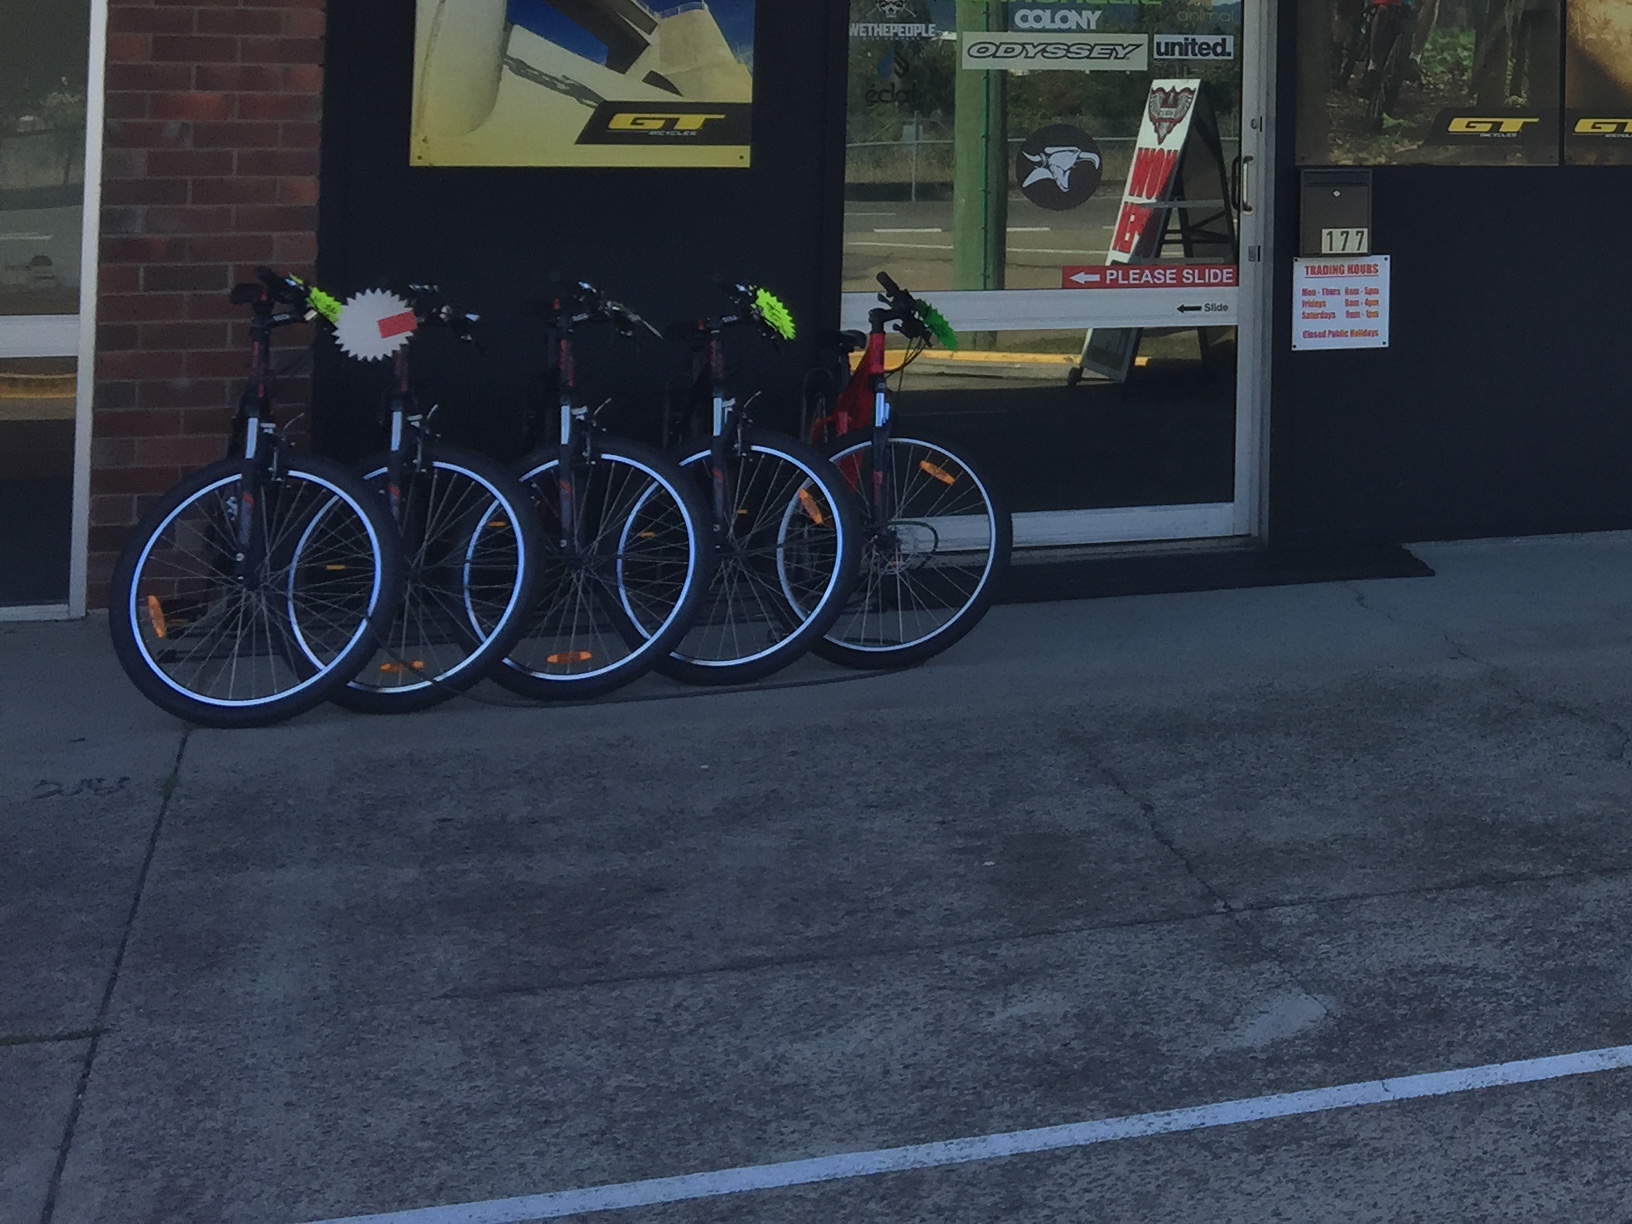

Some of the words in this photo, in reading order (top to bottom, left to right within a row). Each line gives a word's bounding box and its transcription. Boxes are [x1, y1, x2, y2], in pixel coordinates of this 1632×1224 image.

[1014, 9, 1102, 30] COLONY
[1176, 9, 1234, 23] animal
[849, 22, 936, 37] WETHEPEOPLE
[967, 41, 1143, 60] ODYSSEY
[1155, 36, 1232, 58] united.
[608, 113, 725, 130] GT
[1448, 117, 1539, 132] GT
[1326, 230, 1365, 252] 177
[1105, 269, 1178, 284] PLEASE
[1182, 268, 1233, 284] SLIDE
[1304, 264, 1345, 276] TRADING
[1347, 263, 1379, 275] HOURS
[1204, 302, 1229, 312] Slide
[1302, 311, 1336, 320] Saturdays
[1302, 330, 1326, 339] Closed
[1327, 329, 1349, 338] Public
[1350, 328, 1379, 338] Holidays
